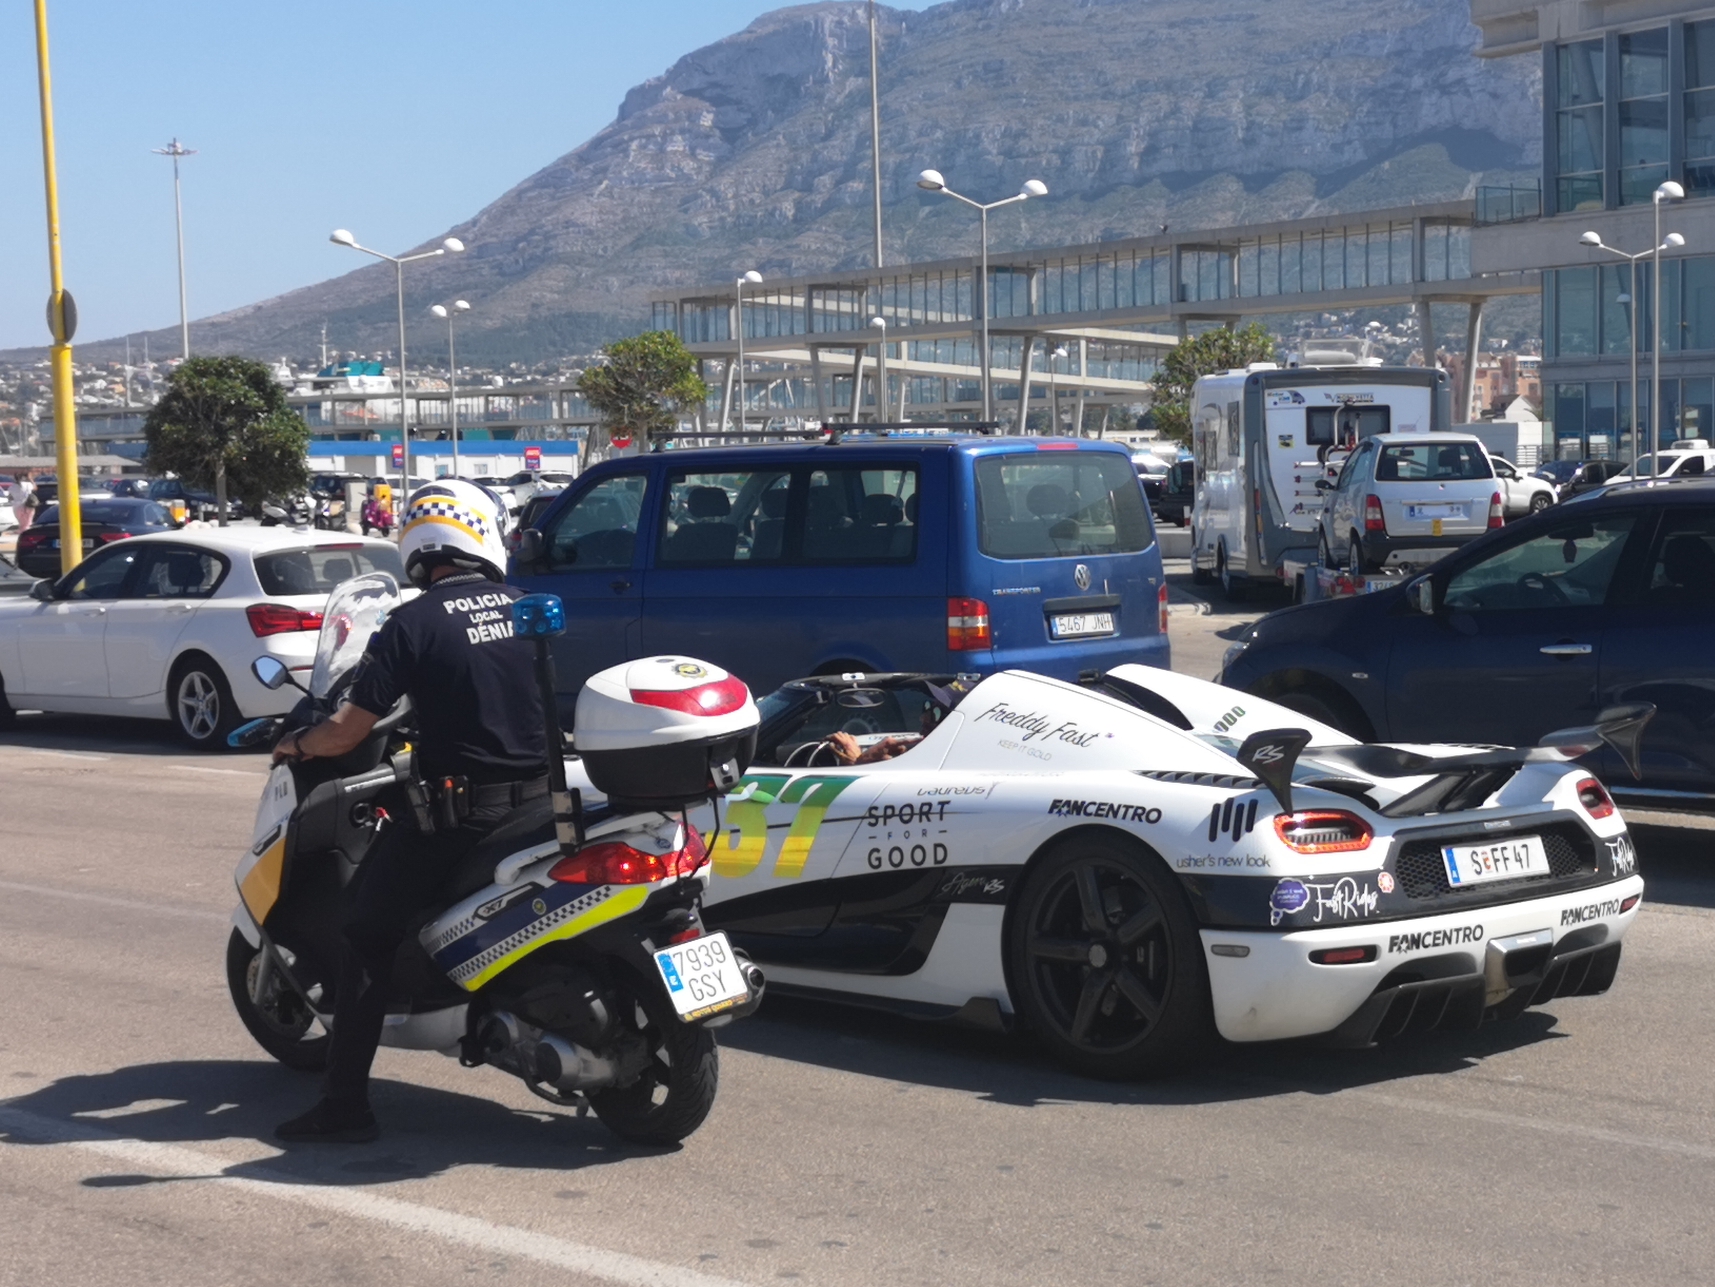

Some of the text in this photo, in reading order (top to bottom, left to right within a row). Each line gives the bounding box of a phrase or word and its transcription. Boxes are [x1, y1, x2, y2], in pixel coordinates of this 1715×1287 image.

[443, 593, 513, 614] POLICIA
[469, 610, 503, 624] LOCAL
[1058, 614, 1112, 633] 5467 JNH
[974, 702, 1099, 748] Freddy Fast
[998, 739, 1019, 750] KEEP
[1026, 747, 1053, 762] GOLD
[1252, 745, 1284, 765] RS
[867, 801, 952, 828] SPORT
[1048, 799, 1163, 824] FANCENTRO
[887, 829, 928, 841] FOR
[867, 843, 948, 869] GOOD
[1176, 853, 1271, 868] usher's new look
[1470, 850, 1483, 876] S
[1512, 843, 1531, 871] 47
[1560, 898, 1620, 926] FANCENTRO
[1388, 924, 1484, 953] FANCENTRO
[672, 940, 726, 977] 7939
[688, 969, 726, 1002] GSY
